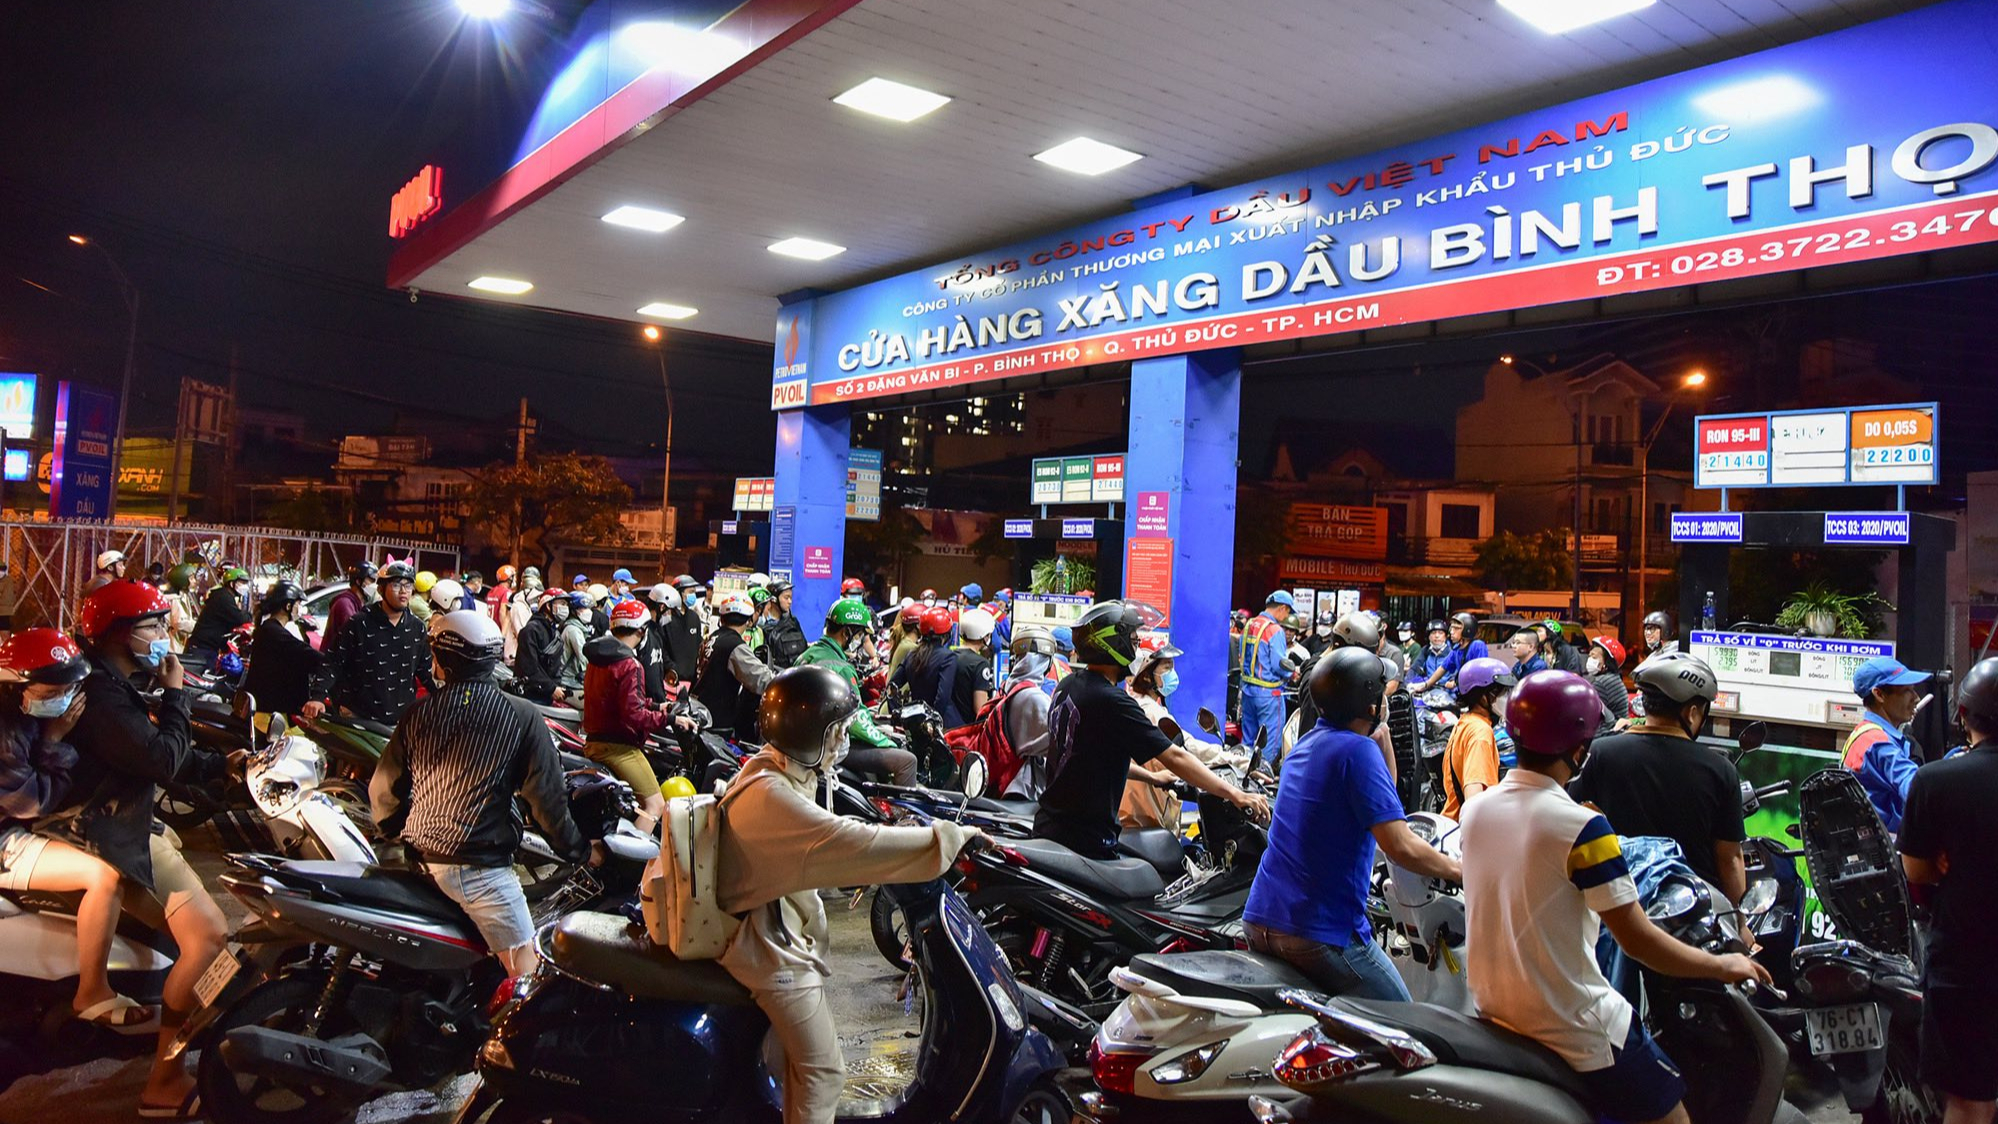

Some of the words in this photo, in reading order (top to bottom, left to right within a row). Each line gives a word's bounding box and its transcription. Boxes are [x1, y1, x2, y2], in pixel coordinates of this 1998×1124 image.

[934, 258, 1019, 291] TỔNG
[1029, 229, 1136, 266] CÔNG
[1141, 214, 1194, 242] TY
[1209, 187, 1311, 225] DẦU
[1327, 154, 1456, 197] VIỆT
[1479, 110, 1629, 164] NAM
[902, 298, 948, 318] CÔNG
[953, 291, 977, 307] TY
[981, 277, 1006, 298] CỔ
[1011, 268, 1064, 294] PHẦN
[1070, 246, 1165, 277] THƯƠNG
[1173, 235, 1221, 257] MẠI
[1230, 216, 1306, 244] XUẤT
[1315, 198, 1403, 230] NHẬP
[1415, 170, 1516, 209] KHẨU
[1528, 145, 1613, 182] THỦ
[1630, 124, 1731, 162] ĐỨC
[838, 329, 911, 371] CỬA
[920, 302, 1042, 358] HÀNG
[1056, 272, 1220, 331] XĂNG
[1240, 233, 1402, 301] DẦU
[1430, 186, 1659, 271] BÌNH
[1702, 122, 1998, 222] THỌ
[835, 380, 854, 396] SỐ
[857, 383, 864, 393] 2
[867, 372, 907, 392] ĐẶNG
[910, 366, 940, 387] VĂN
[944, 367, 960, 381] BI
[974, 360, 990, 375] P.
[994, 350, 1037, 372] BÌNH
[1041, 346, 1081, 363] THỌ
[1104, 341, 1126, 356] Q.
[1131, 327, 1177, 353] THỦ
[1184, 322, 1240, 344] ĐỨC
[1262, 314, 1303, 335] TP.
[1314, 303, 1380, 327] HCM
[1597, 261, 1660, 286] ĐT:
[774, 383, 805, 405] PVOIL
[1706, 430, 1728, 444] RON
[1731, 428, 1760, 442] 95-III
[1864, 422, 1881, 436] DO
[1883, 420, 1917, 438] 0,05S
[79, 441, 106, 455] PVOIL
[1867, 448, 1931, 463] 22200
[1709, 454, 1765, 468] 21440
[76, 471, 100, 488] XĂNG
[1827, 520, 1847, 534] TCCS
[1286, 559, 1335, 574] MOBILE
[845, 612, 863, 621] Grab
[1701, 634, 1721, 643] TRẢ
[1724, 634, 1740, 645] SỐ
[1782, 640, 1823, 651] TRƯỚC
[1826, 643, 1847, 653] KHI
[1851, 644, 1881, 655] BƠM
[1816, 1007, 1868, 1030] 76-C1
[1814, 1027, 1878, 1052] 318.84
